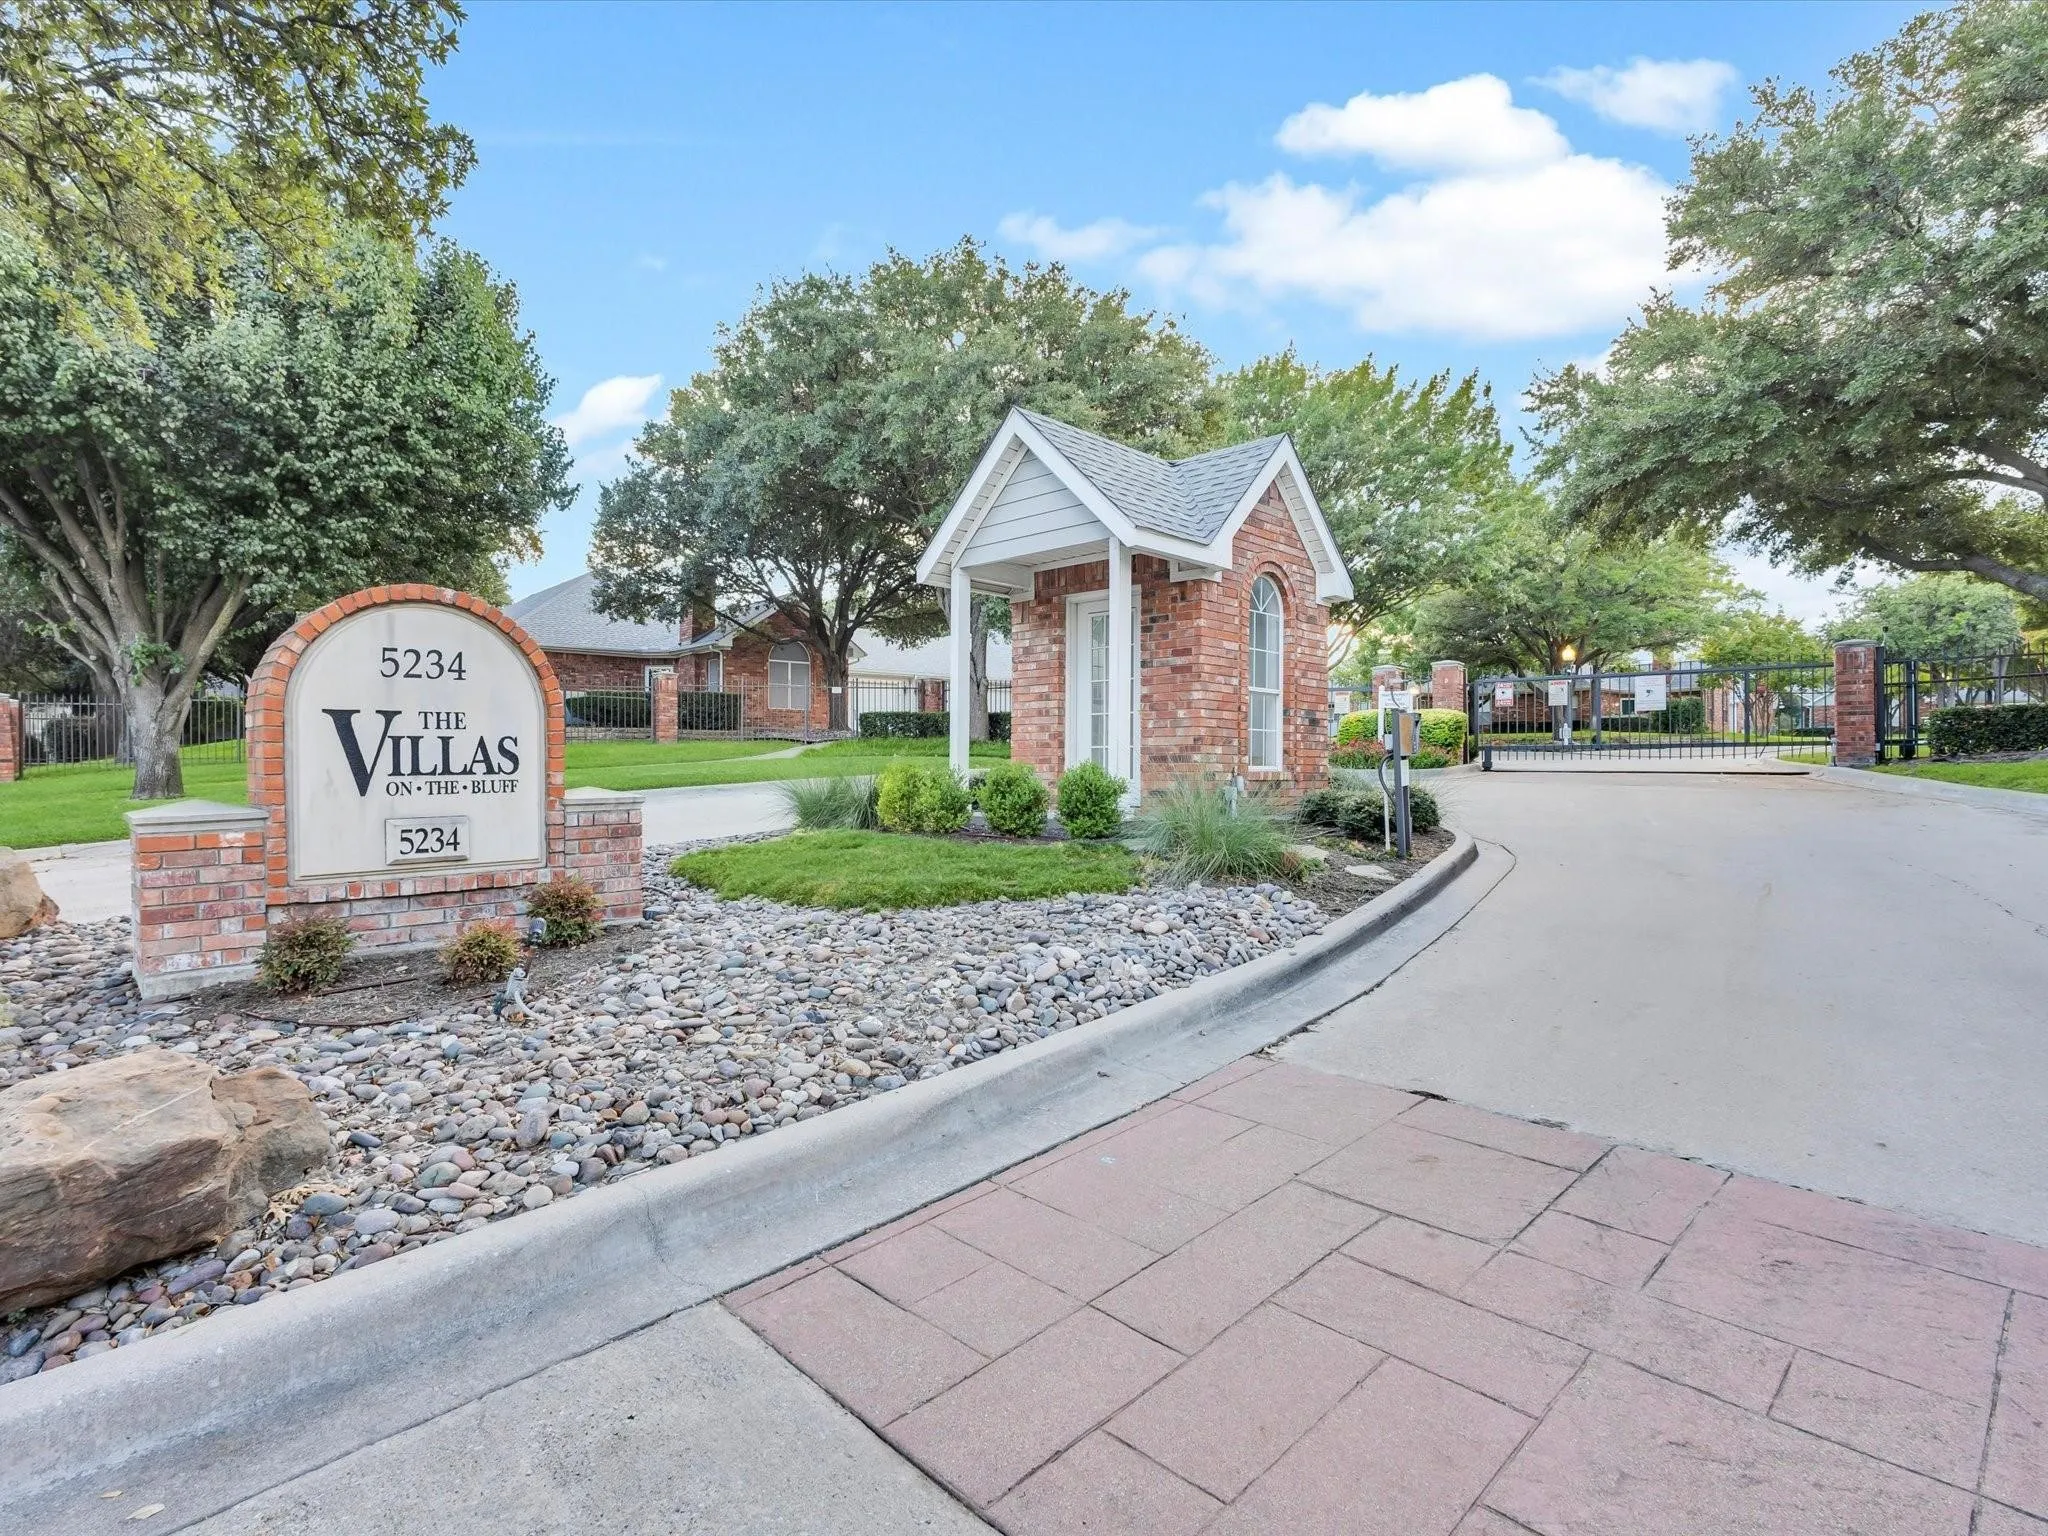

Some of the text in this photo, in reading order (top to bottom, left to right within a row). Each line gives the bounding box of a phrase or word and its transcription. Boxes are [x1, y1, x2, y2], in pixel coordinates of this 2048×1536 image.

[380, 647, 467, 681] 5234
[418, 711, 467, 730] THE
[321, 708, 520, 797] VILLAS
[471, 779, 519, 794] BLUFF
[399, 827, 461, 855] 5234
